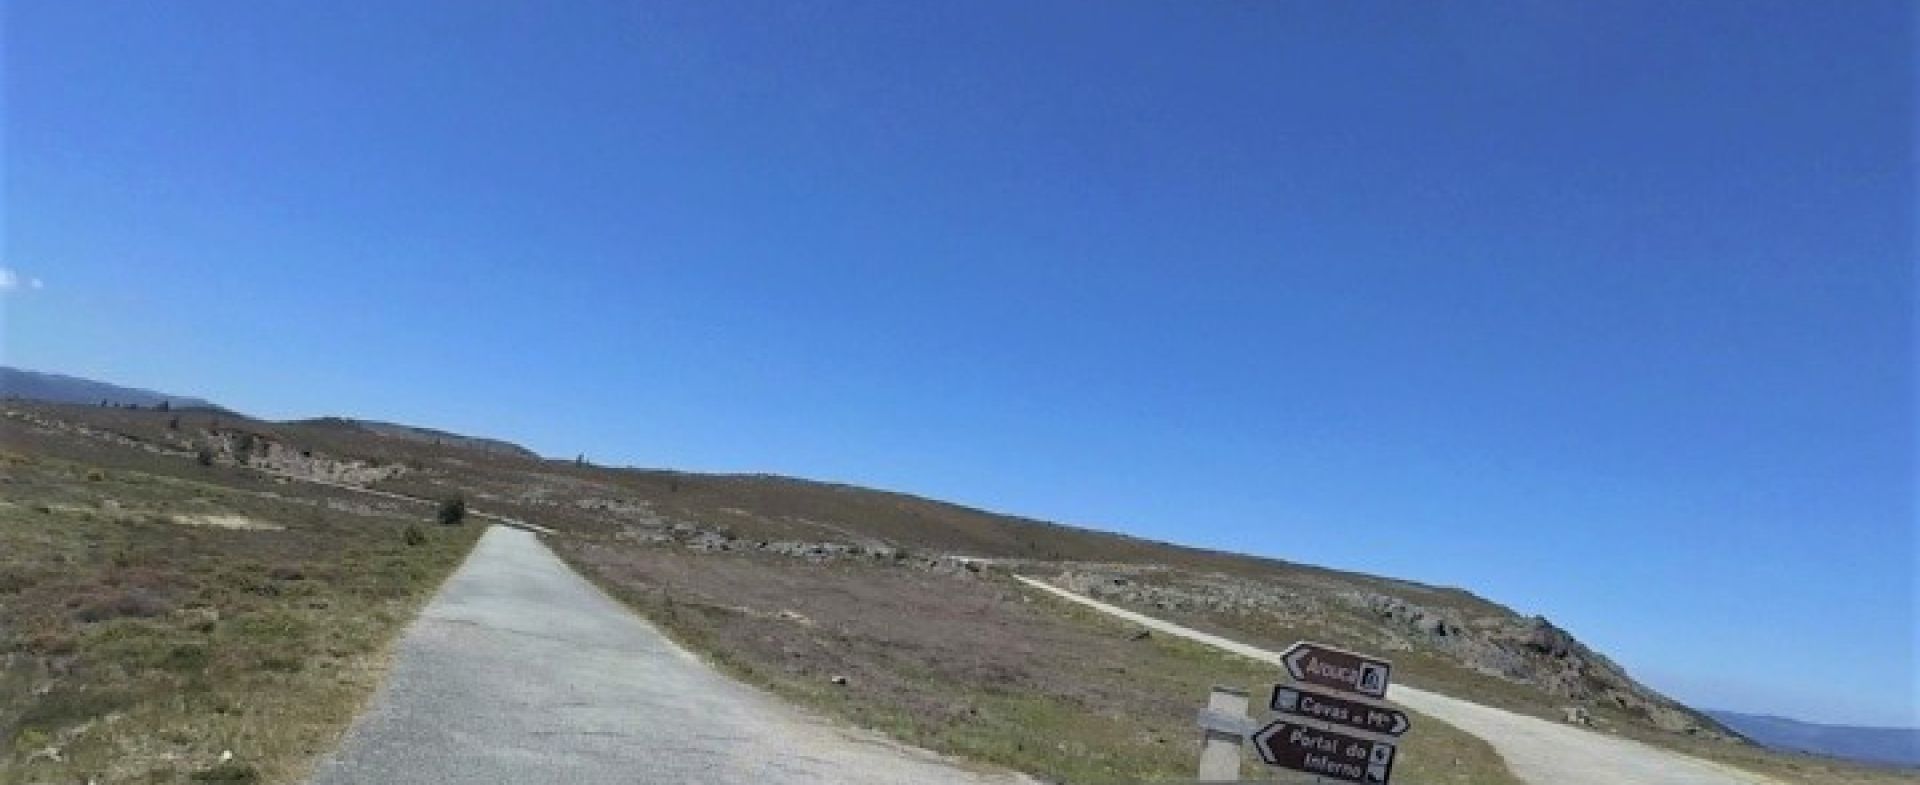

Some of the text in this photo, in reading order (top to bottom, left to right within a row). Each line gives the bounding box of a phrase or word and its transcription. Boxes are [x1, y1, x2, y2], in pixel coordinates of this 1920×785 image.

[1307, 656, 1359, 684] Arouca
[1301, 697, 1348, 719] Covas
[1290, 729, 1366, 759] Portal do
[1304, 753, 1361, 778] Inferno
